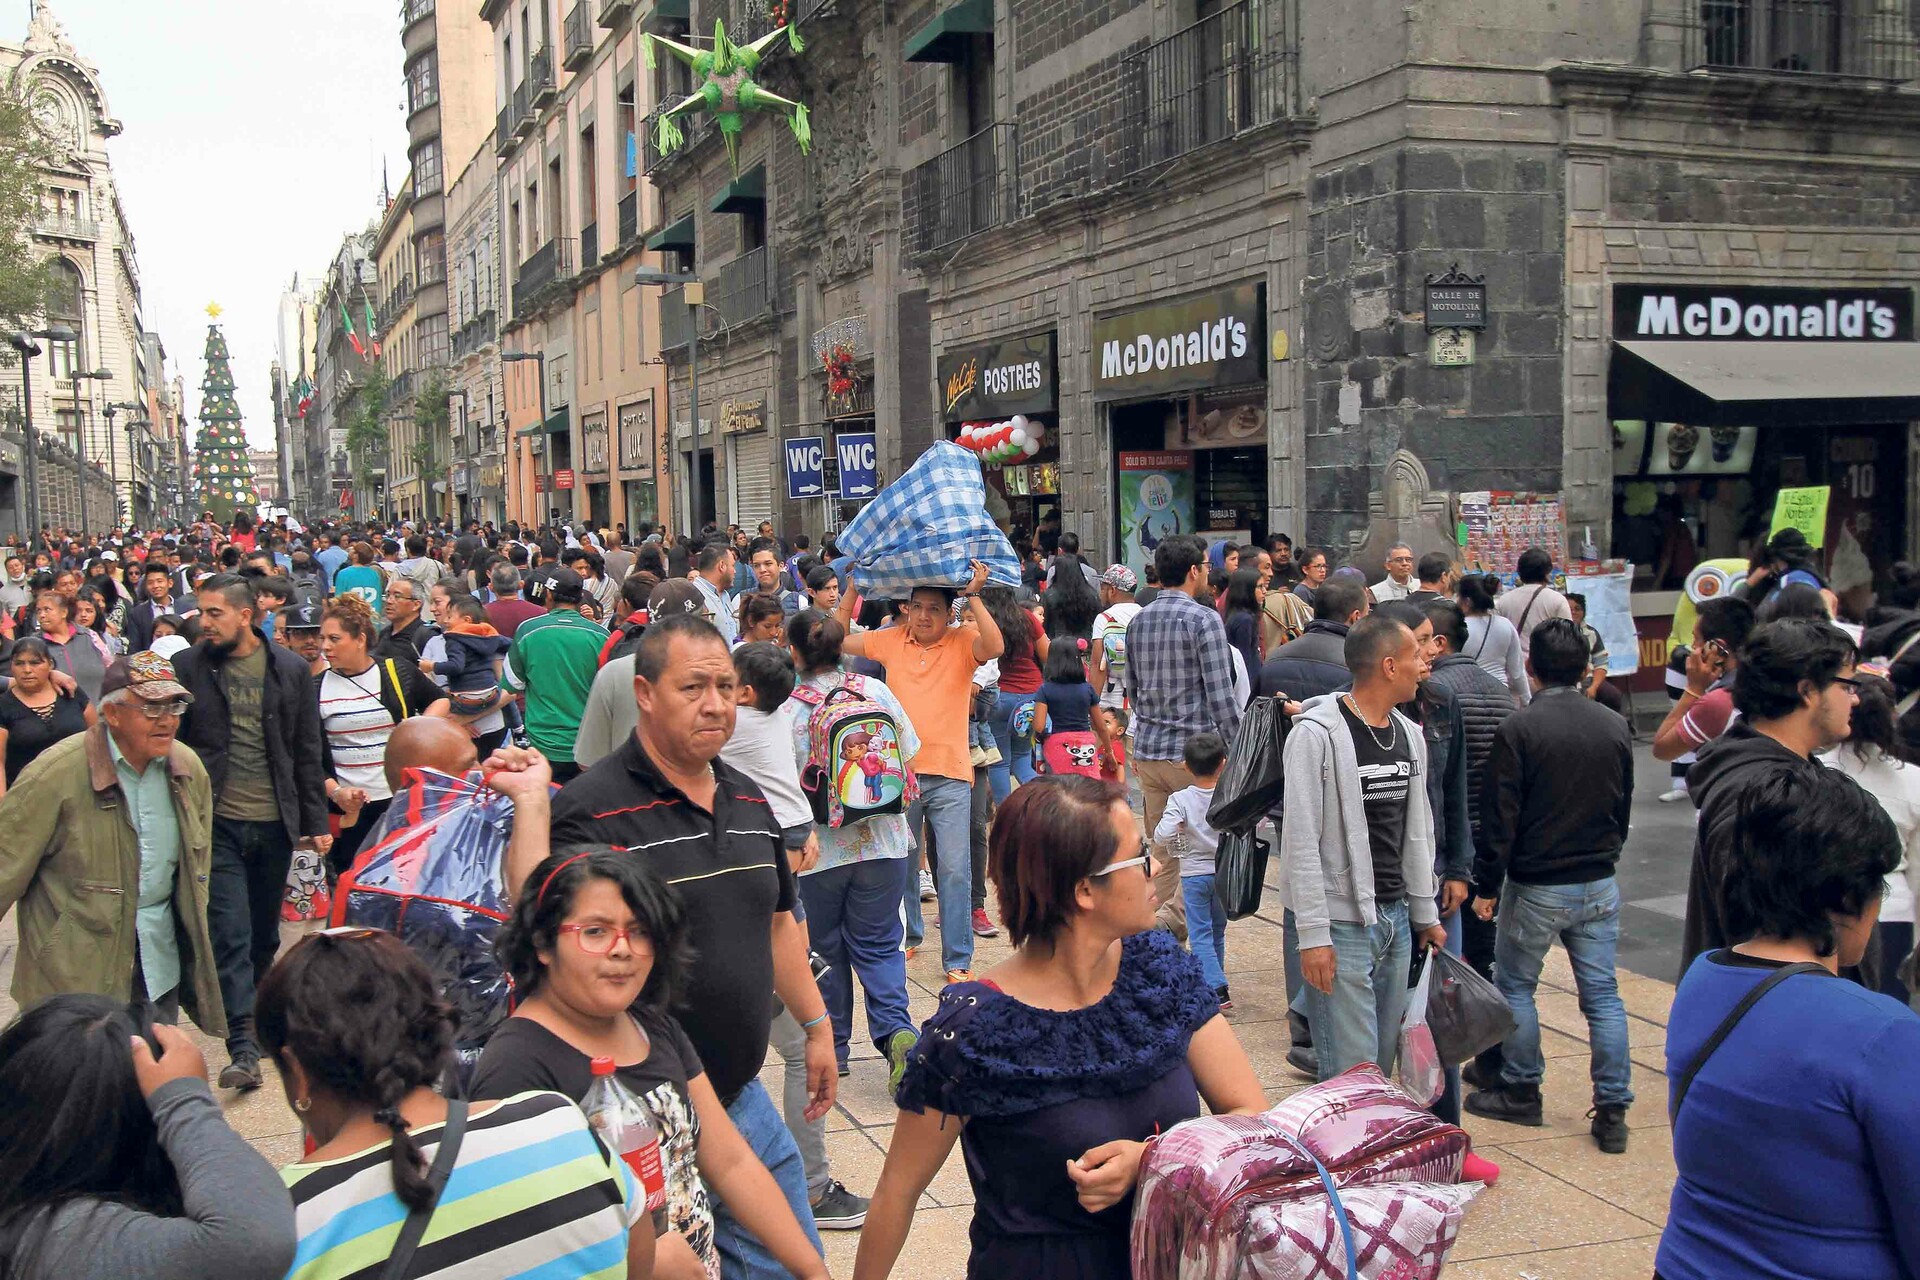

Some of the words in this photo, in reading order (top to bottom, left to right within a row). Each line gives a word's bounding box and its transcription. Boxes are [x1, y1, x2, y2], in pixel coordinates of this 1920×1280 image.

[1431, 303, 1480, 311] MOTOLINIA
[1637, 295, 1896, 338] McDonald's
[1101, 316, 1247, 379] McDonald's
[984, 361, 1041, 395] POSTRES
[623, 411, 648, 427] OPTICA
[628, 432, 642, 458] LUX
[840, 442, 876, 471] WC
[789, 446, 822, 473] WC
[1125, 455, 1139, 466] SÓLO
